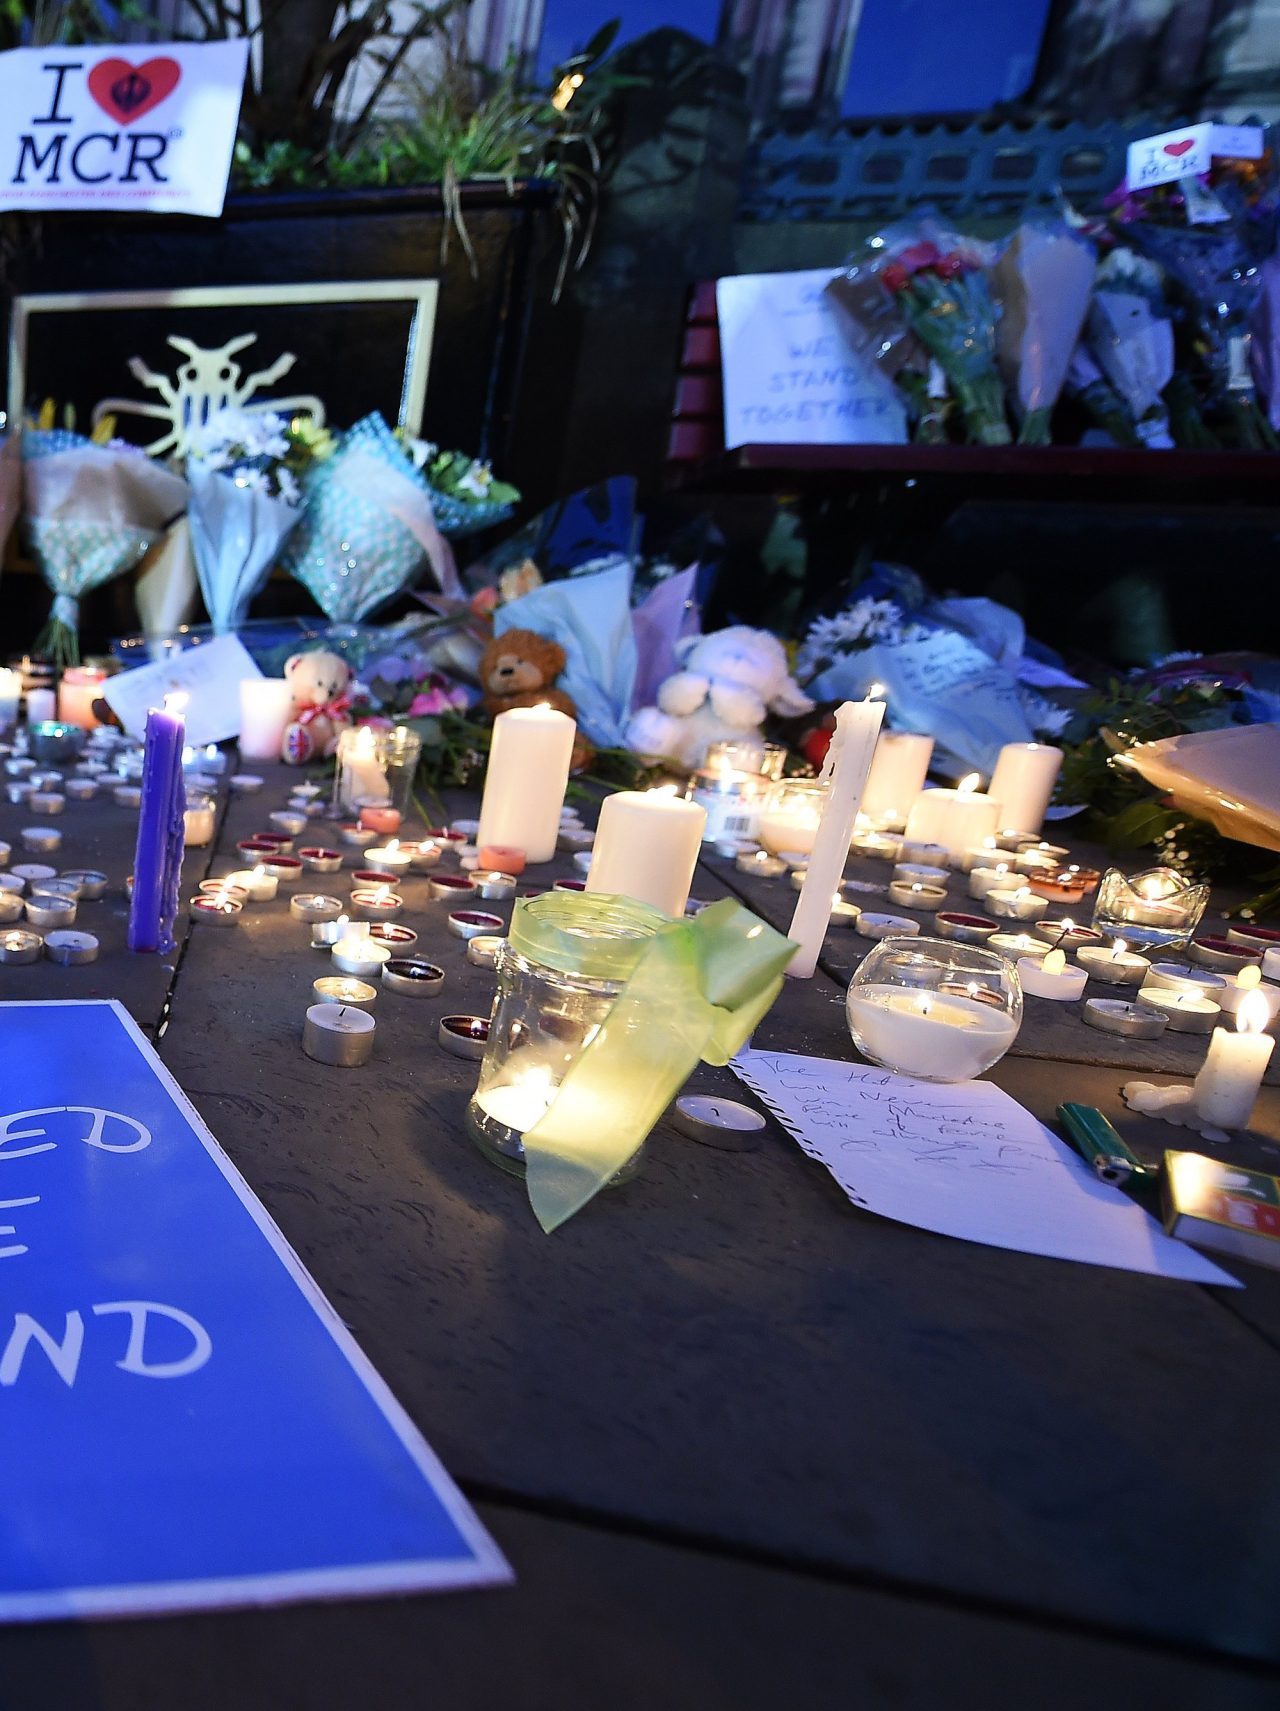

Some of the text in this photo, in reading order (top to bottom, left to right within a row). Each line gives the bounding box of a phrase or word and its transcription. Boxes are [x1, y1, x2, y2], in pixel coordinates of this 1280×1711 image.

[32, 63, 83, 125] I
[11, 133, 169, 184] MCR
[767, 366, 860, 393] STAND
[744, 1056, 819, 1077] The
